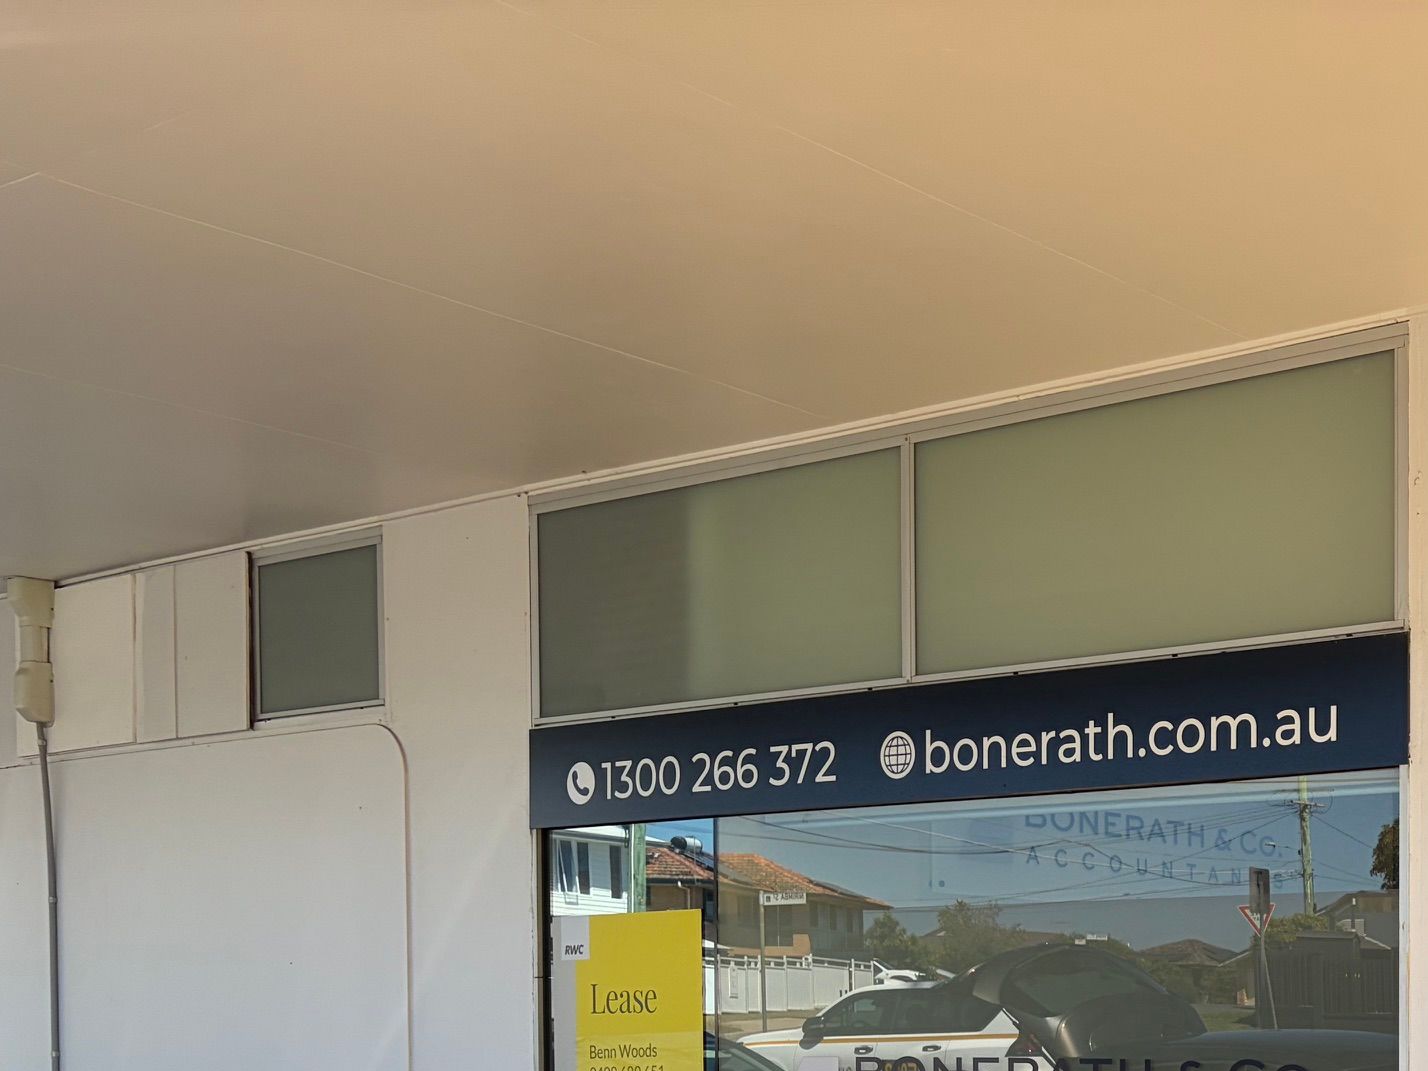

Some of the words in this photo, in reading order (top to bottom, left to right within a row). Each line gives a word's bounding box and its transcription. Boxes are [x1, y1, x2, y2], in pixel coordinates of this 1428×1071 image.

[925, 704, 1338, 774] bonerath.com.au
[601, 755, 681, 800] 1300
[691, 748, 759, 793] 266
[768, 740, 837, 787] 372
[1214, 828, 1232, 851] &
[1026, 846, 1284, 890] ACCOUNTANS
[565, 945, 584, 955] RWC
[590, 983, 658, 1015] Lease
[589, 1044, 617, 1060] Benn
[618, 1042, 658, 1059] Woods
